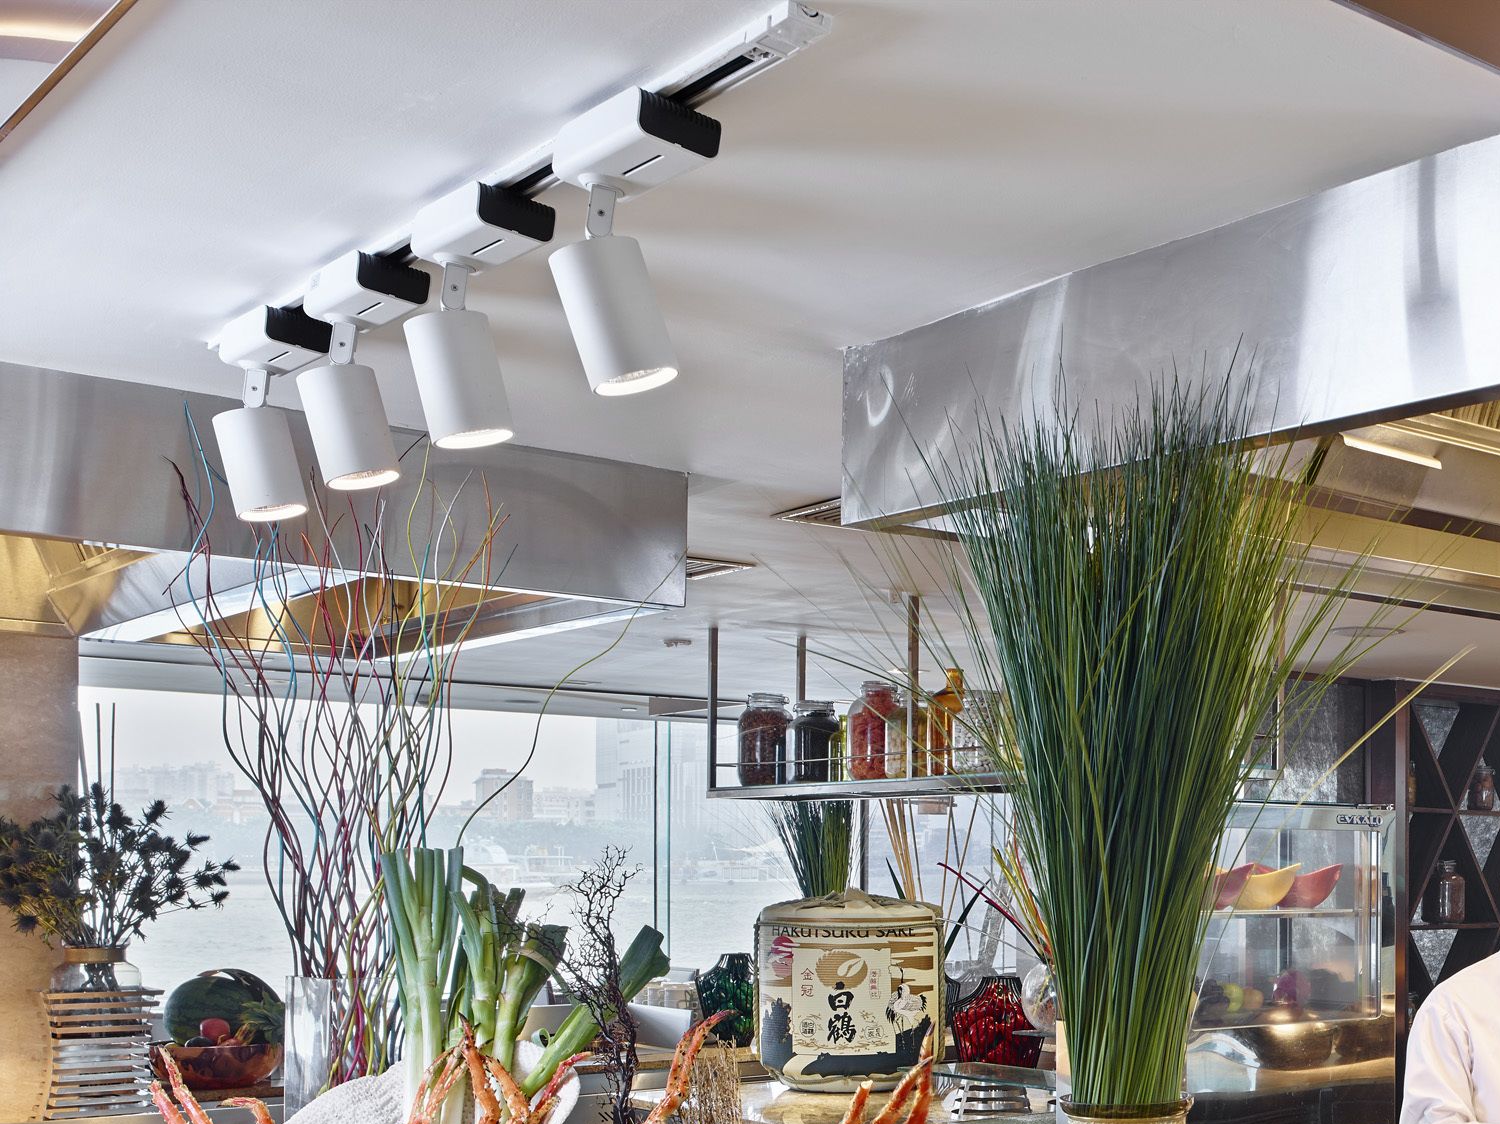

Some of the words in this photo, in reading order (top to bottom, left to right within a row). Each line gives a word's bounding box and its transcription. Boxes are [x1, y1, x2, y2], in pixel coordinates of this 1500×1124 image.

[875, 926, 916, 938] SAKE
[801, 968, 814, 997] 金冠
[827, 981, 857, 1044] 白鶴
